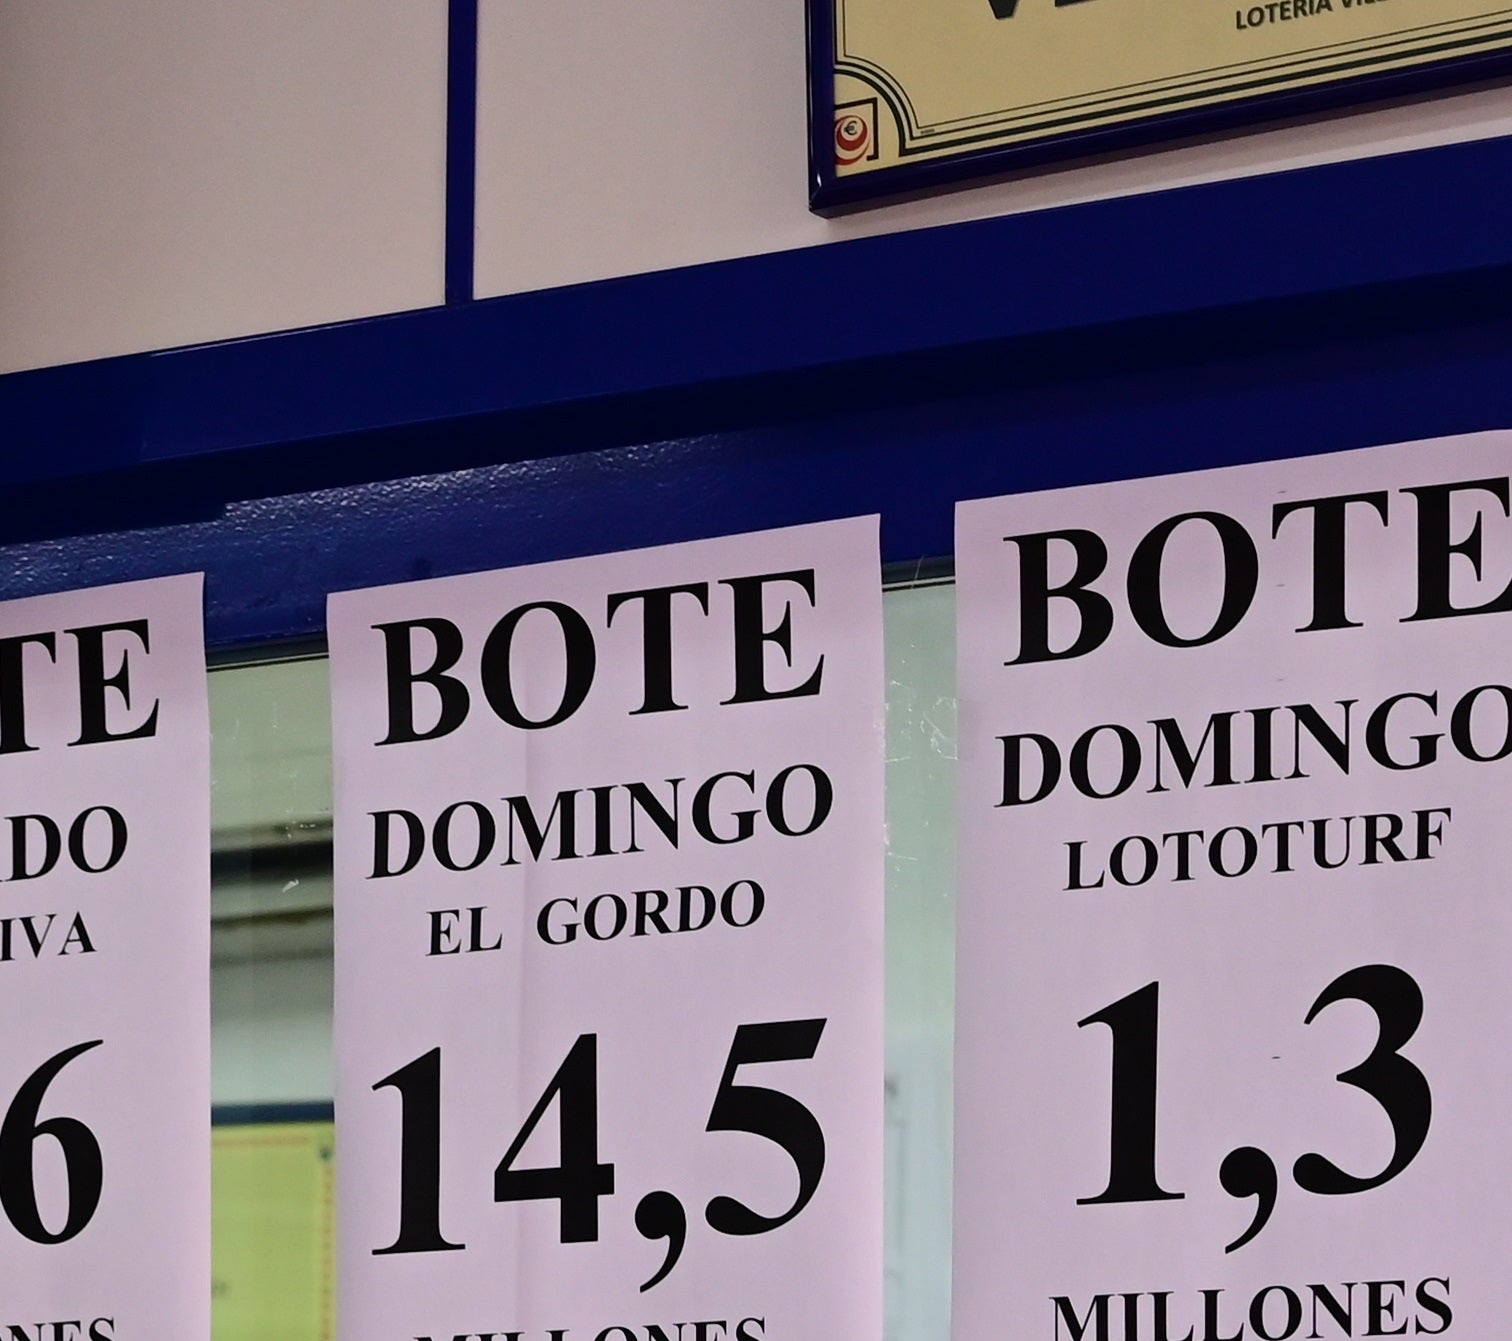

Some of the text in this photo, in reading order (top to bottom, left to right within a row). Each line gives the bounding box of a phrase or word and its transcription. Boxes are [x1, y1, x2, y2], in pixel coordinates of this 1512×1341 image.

[371, 568, 827, 747] BOTE
[366, 763, 833, 881] DOMINGO
[1064, 807, 1452, 893] LOTOTURF
[426, 879, 766, 957] EL GORDO
[371, 1017, 828, 1292] 14,5
[1075, 962, 1433, 1254] 1,3
